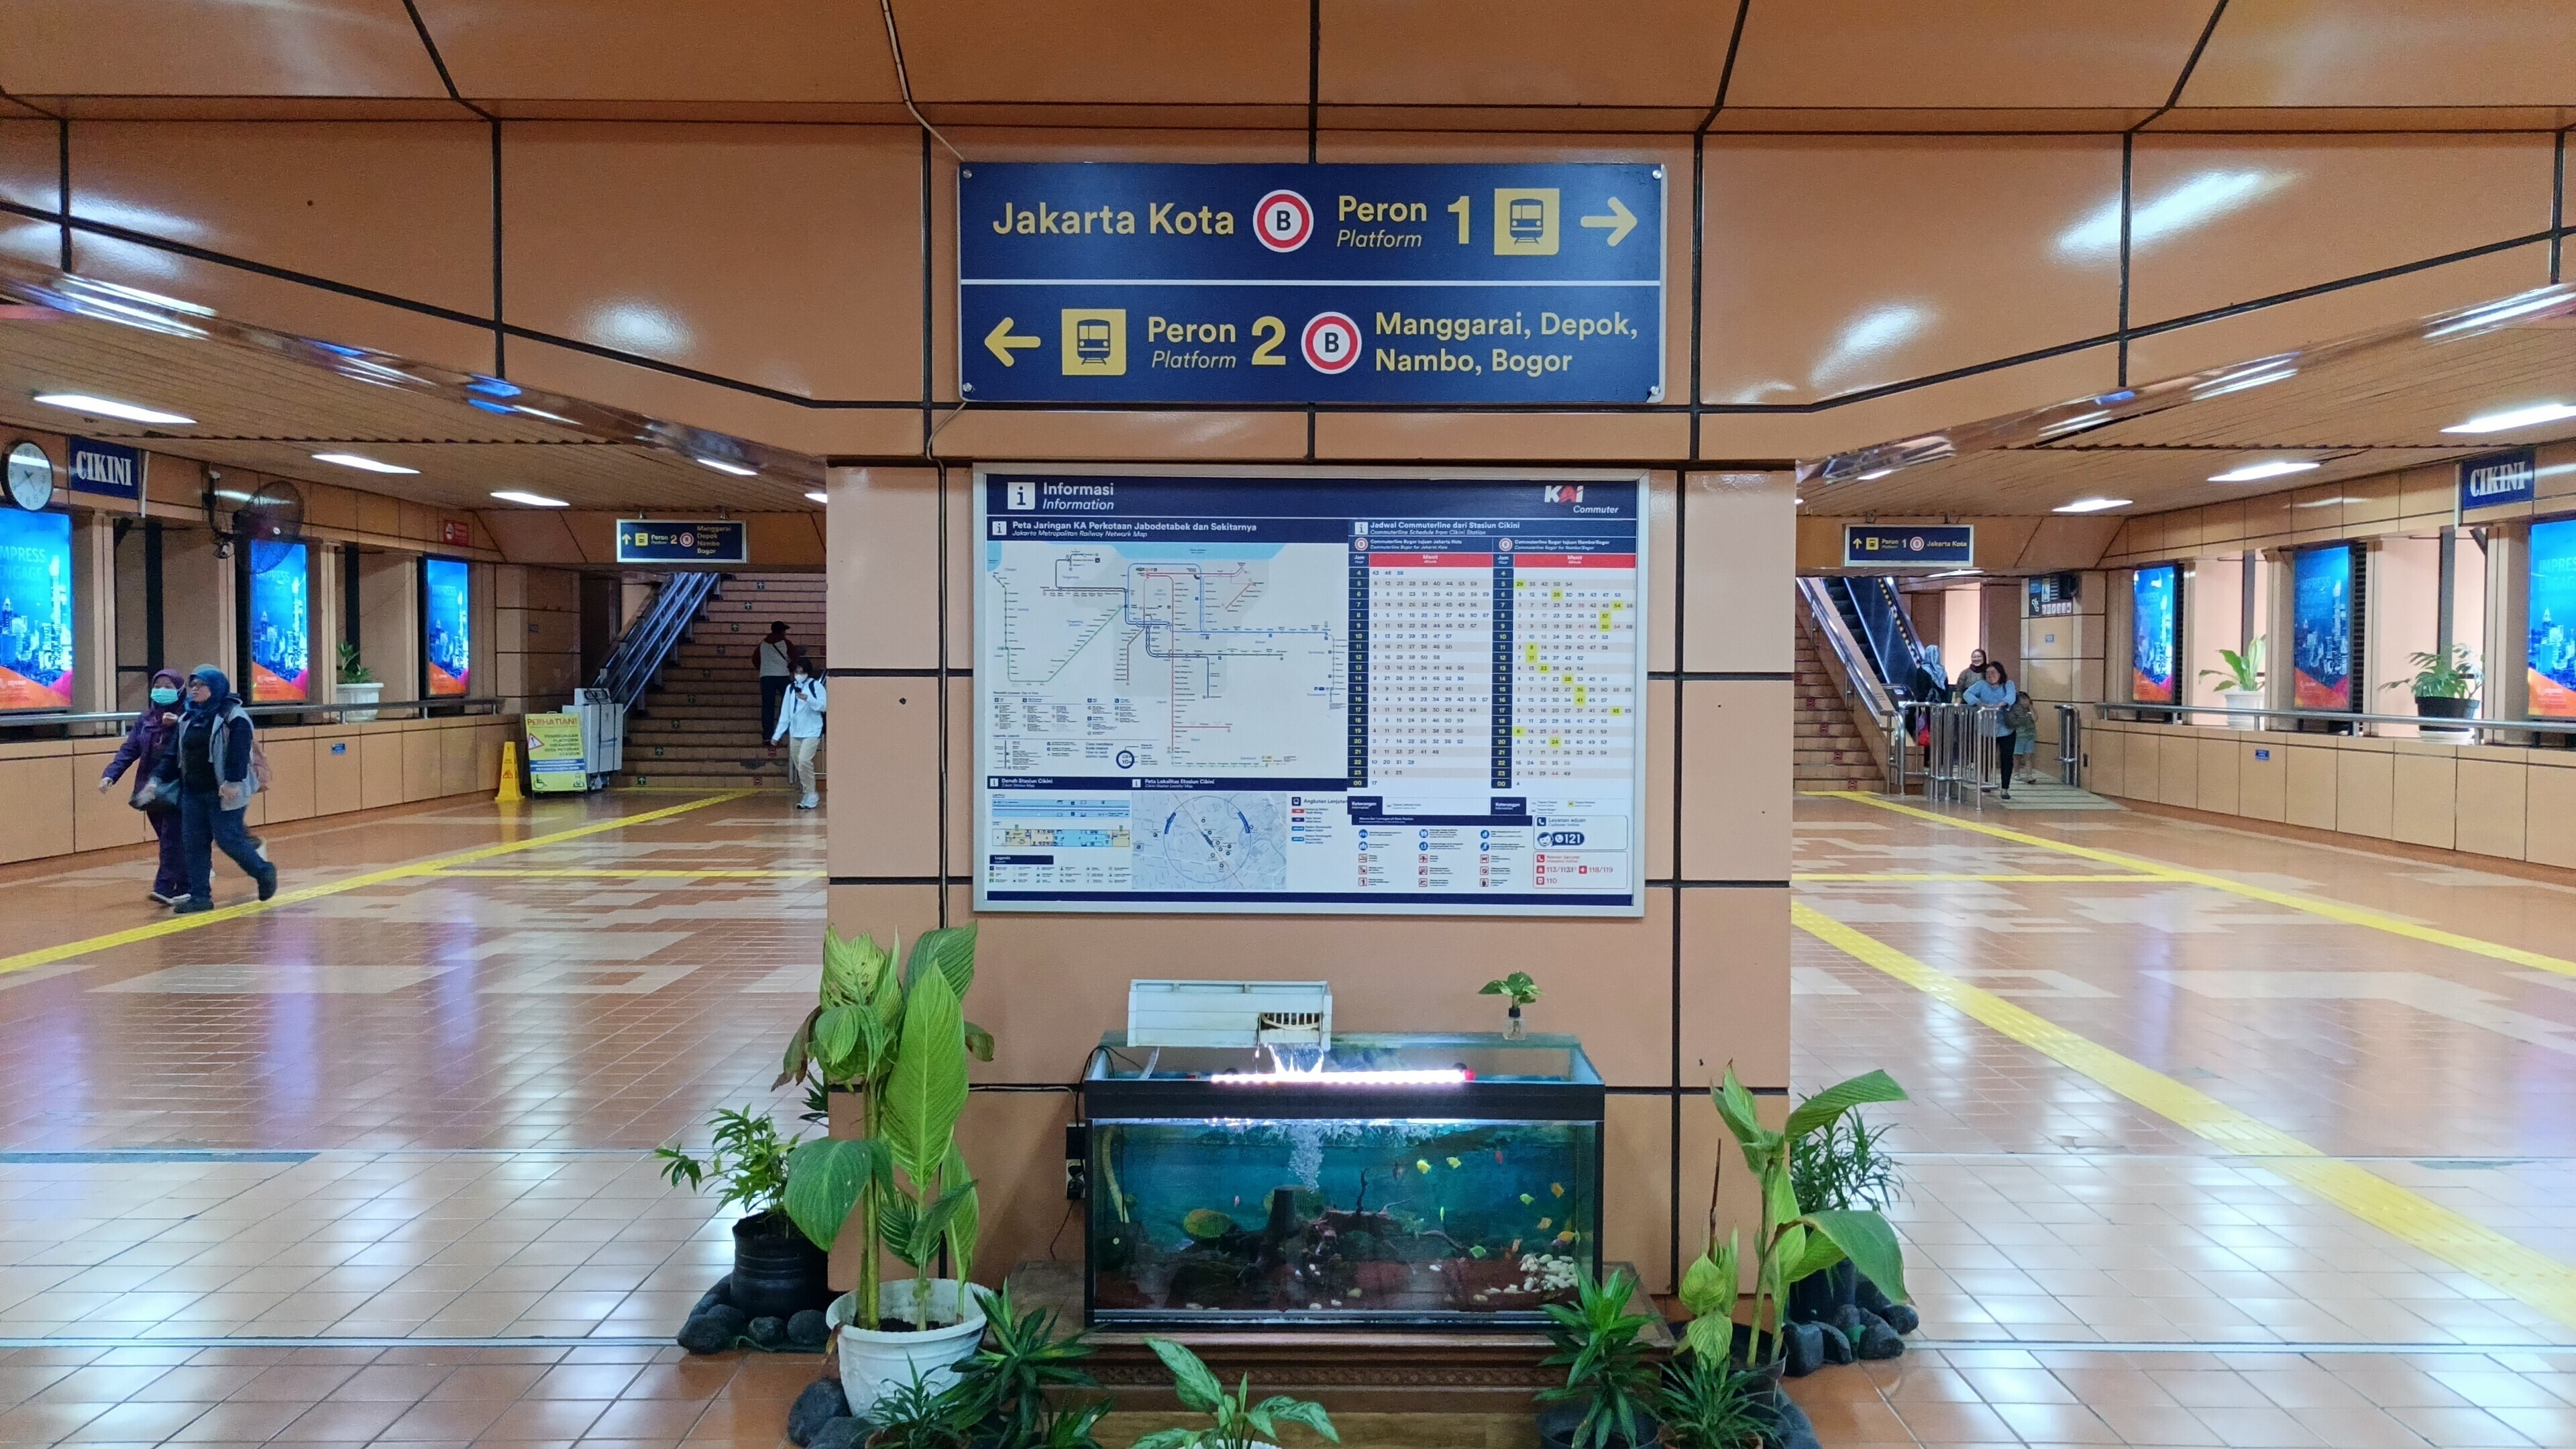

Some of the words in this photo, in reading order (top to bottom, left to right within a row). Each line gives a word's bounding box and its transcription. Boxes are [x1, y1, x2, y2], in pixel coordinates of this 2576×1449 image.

[994, 203, 1134, 234] Jakarta
[1150, 203, 1233, 234] Kota
[1274, 211, 1291, 231] B
[1340, 196, 1426, 221] Peron
[1448, 196, 1469, 244] 1
[1337, 229, 1421, 248] Platform
[1377, 311, 1531, 339] Manggarai,
[1542, 312, 1637, 340] Depok,
[1148, 317, 1235, 342] Peron
[1252, 316, 1285, 365] 2
[1323, 333, 1338, 352] B
[1152, 351, 1236, 368] Platform
[1377, 348, 1481, 376] Nambo,
[1493, 349, 1572, 377] Bogor
[76, 450, 132, 486] CIKINI
[1044, 482, 1114, 495] Informasi
[2470, 462, 2525, 497] CIKINI
[1043, 498, 1114, 510] Information
[1544, 486, 1584, 503] KAI
[1573, 505, 1619, 513] Commuter
[1033, 521, 1071, 531] Jaringan
[1211, 523, 1256, 532] Sekitarnya
[671, 535, 677, 544] 2
[1902, 539, 1906, 548] 1
[0, 545, 46, 564] MPRESS
[2539, 556, 2576, 573] IMPRES
[1564, 834, 1580, 844] 121
